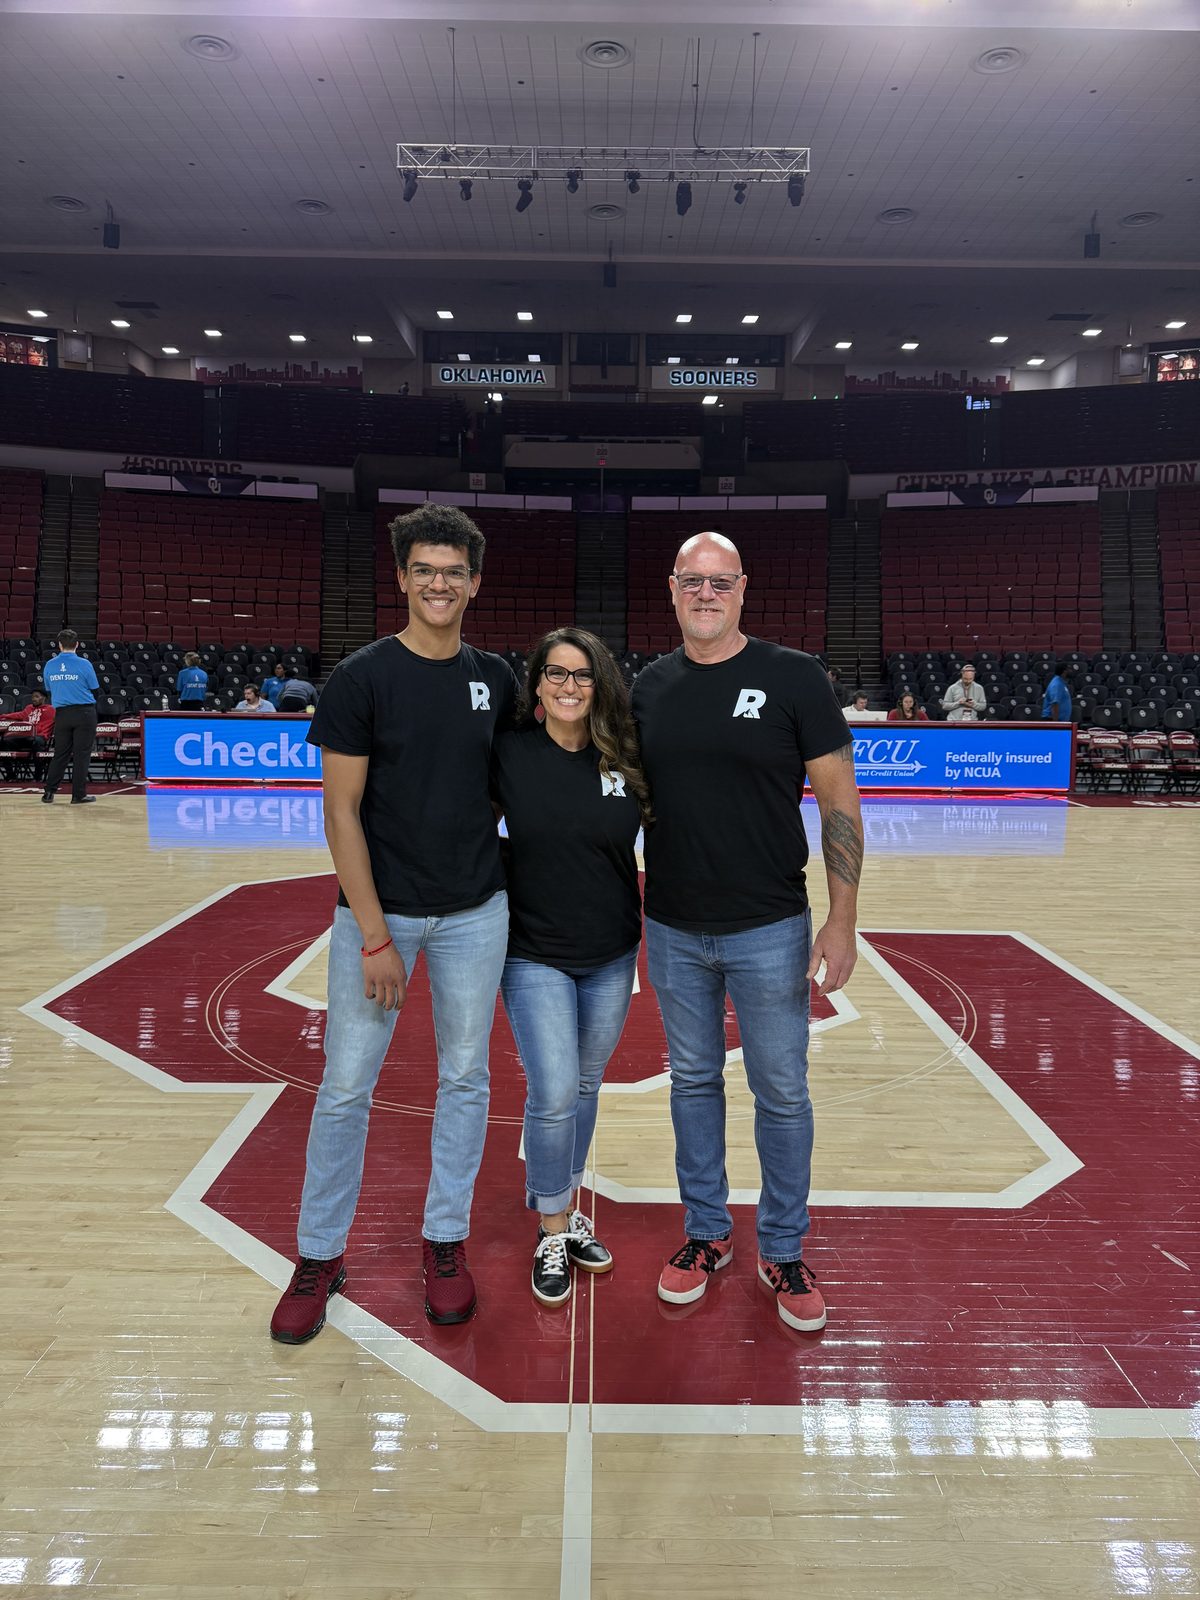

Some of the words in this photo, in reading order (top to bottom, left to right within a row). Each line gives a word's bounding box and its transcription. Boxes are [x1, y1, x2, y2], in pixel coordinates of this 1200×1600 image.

[440, 367, 547, 384] OKLAHOMA
[670, 370, 759, 387] SOONERS
[1064, 463, 1198, 488] CHAMPION
[50, 674, 64, 682] EVENT
[468, 681, 491, 711] R
[732, 688, 767, 719] R
[174, 731, 321, 767] Checki
[945, 751, 1002, 766] Federally
[1006, 752, 1052, 764] insured
[944, 766, 961, 780] by
[964, 769, 1002, 778] NCUA
[600, 770, 627, 798] R
